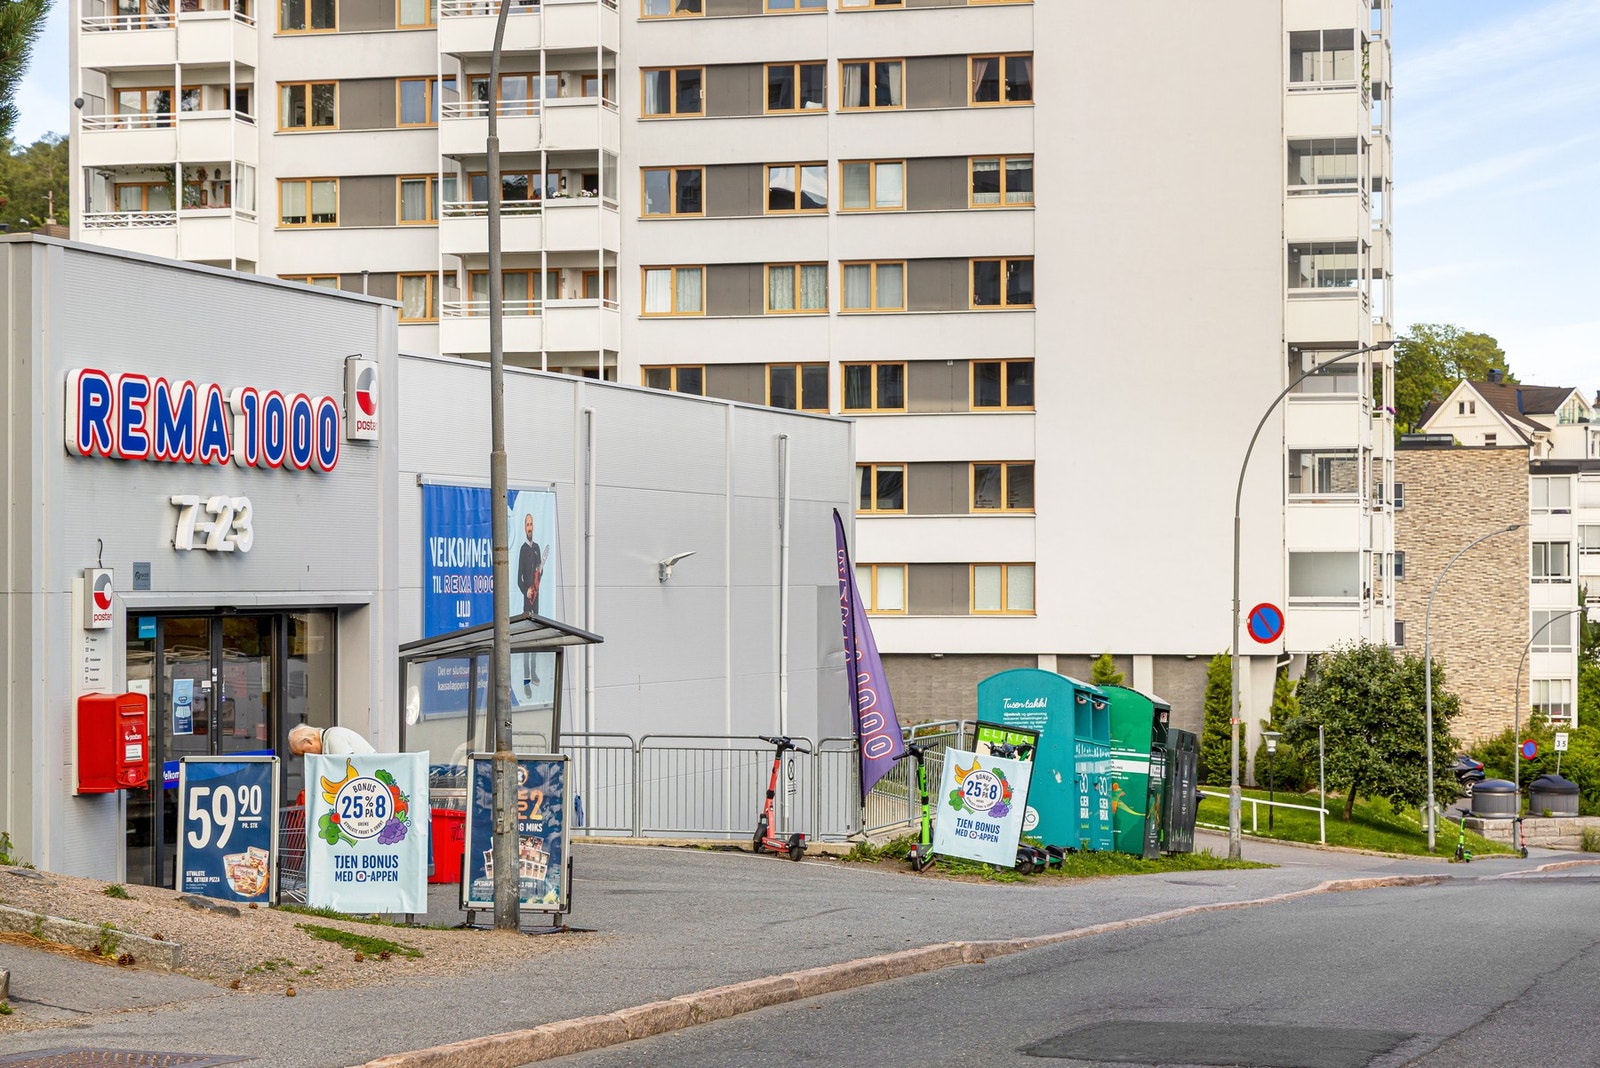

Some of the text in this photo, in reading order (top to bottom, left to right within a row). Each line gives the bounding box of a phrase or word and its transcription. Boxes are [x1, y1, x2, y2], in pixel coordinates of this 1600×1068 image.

[77, 368, 340, 472] REMA 1000
[171, 495, 254, 553] 7-23
[430, 537, 493, 568] VELKOMMEN
[433, 576, 442, 593] TIL
[444, 575, 472, 594] REMA
[984, 728, 1028, 742] ELIXIA
[353, 783, 376, 793] BONUS
[966, 781, 982, 797] 25
[989, 785, 997, 799] 8
[342, 796, 363, 818] 25
[375, 795, 386, 818] 8
[530, 790, 543, 820] 2
[188, 785, 262, 849] 59 90
[956, 818, 1000, 834] TJEN BONUS
[518, 823, 542, 832] G MIKS
[955, 828, 968, 837] MED
[334, 855, 398, 869] TJEN BONUS
[335, 871, 353, 882] MED
